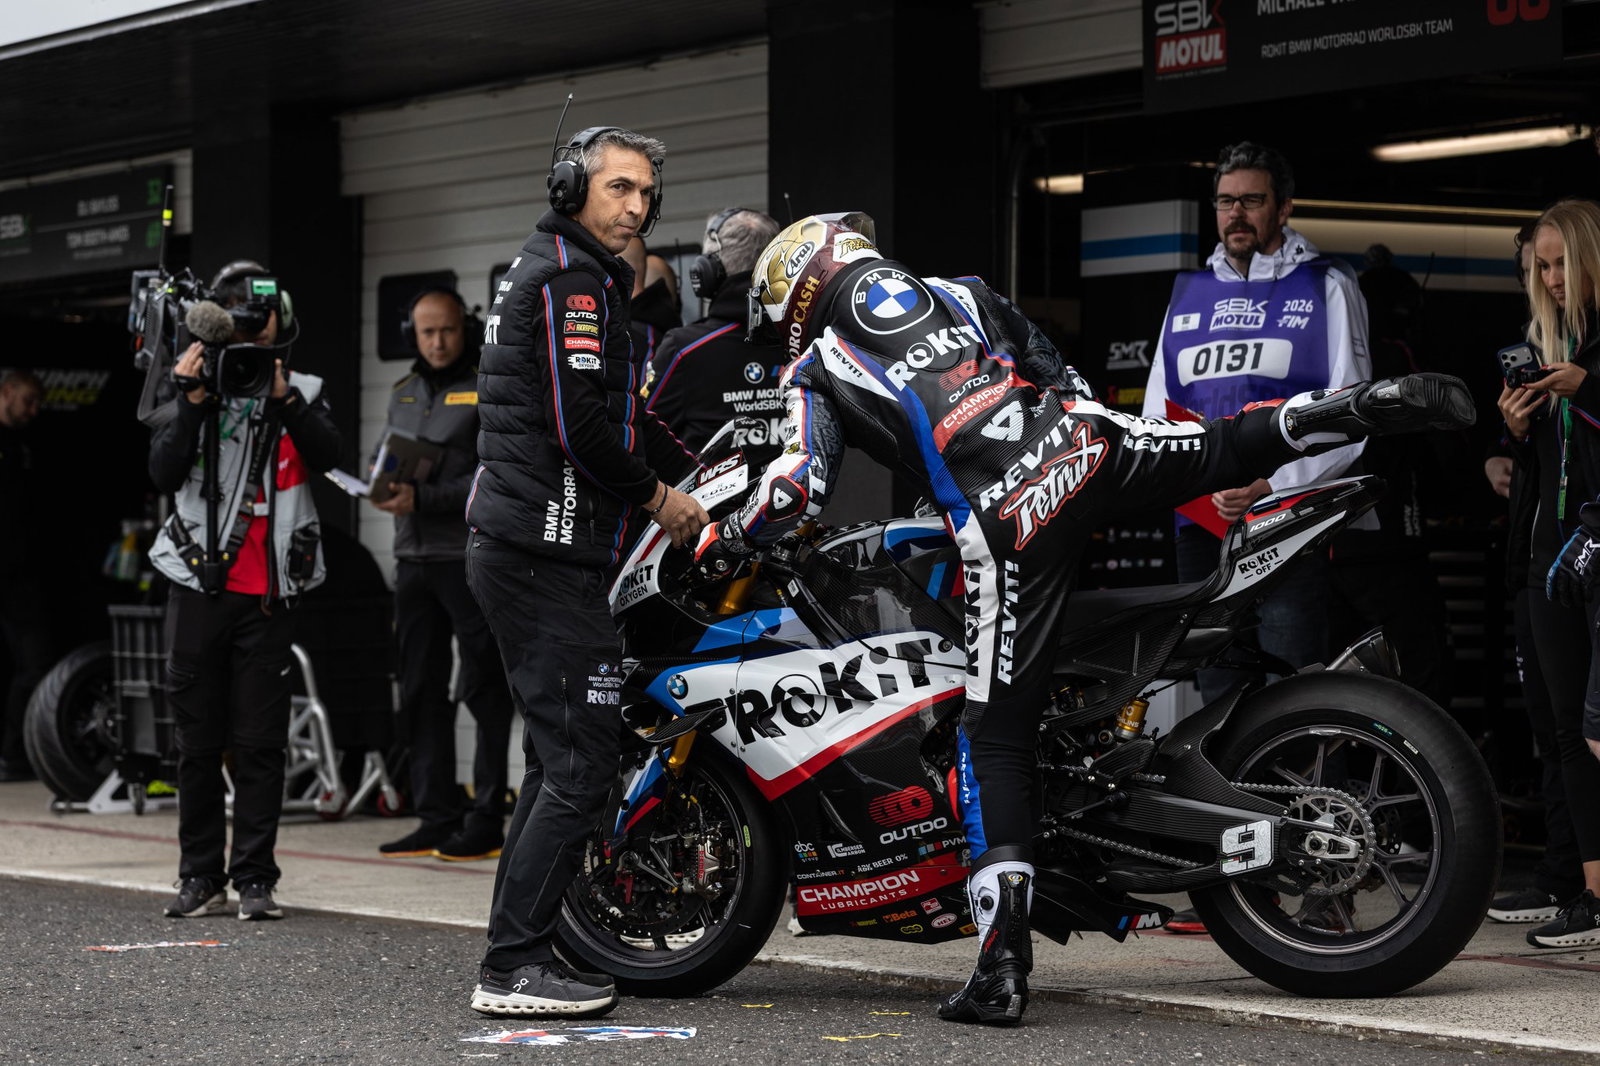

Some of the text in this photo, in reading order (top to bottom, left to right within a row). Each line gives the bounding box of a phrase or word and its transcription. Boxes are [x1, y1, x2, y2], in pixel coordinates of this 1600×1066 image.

[1257, 0, 1325, 17] MICH
[1288, 39, 1313, 55] BMW
[1313, 30, 1367, 51] MOTORRAD
[1368, 22, 1424, 44] WORLDSBK
[1424, 17, 1454, 35] TEAM
[1158, 33, 1224, 69] MOTUL
[565, 311, 598, 321] OUTDO
[1213, 298, 1269, 314] SBK
[1282, 299, 1314, 313] 2026
[1211, 313, 1263, 329] MOTUL
[1276, 314, 1310, 330] FIM
[830, 346, 863, 378] REV'IT!
[884, 324, 984, 392] ROKiT
[1192, 342, 1264, 377] 0131
[722, 389, 754, 403] BMW
[948, 373, 990, 404] OUTDO
[1002, 425, 1107, 546] Petrux
[559, 458, 578, 545] MOTORRA
[543, 499, 560, 543] BMW
[1249, 512, 1287, 533] 1000
[1237, 547, 1280, 574] ROKiT
[1255, 563, 1272, 576] OFF
[618, 564, 655, 596] OKiT
[620, 584, 649, 607] OXYGEN
[998, 560, 1020, 686] REV'IT!
[725, 638, 934, 746] ROKiT
[879, 816, 948, 845] OUTDO
[942, 835, 967, 849] PVM
[794, 840, 815, 853] ebc
[1220, 819, 1274, 877] 9
[872, 857, 894, 869] BEER
[895, 852, 909, 863] 0%
[800, 869, 921, 903] CHAMPION
[820, 889, 908, 910] LUBRICANTS
[890, 910, 918, 922] Beta
